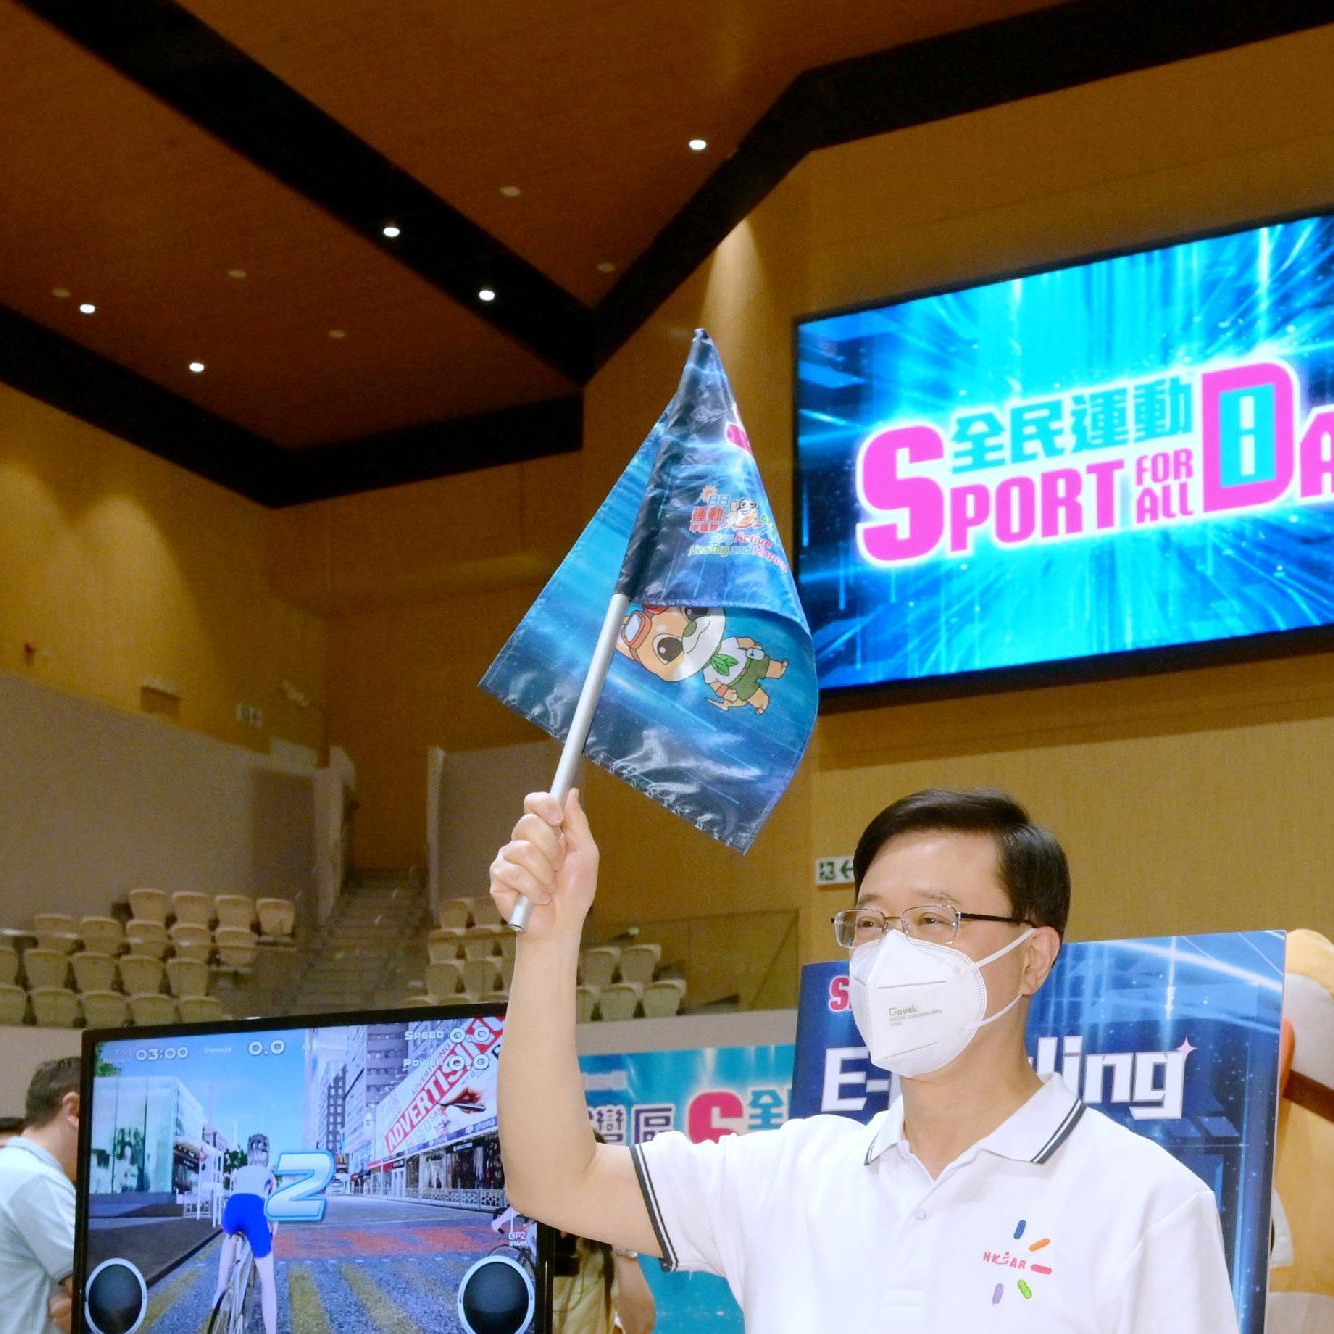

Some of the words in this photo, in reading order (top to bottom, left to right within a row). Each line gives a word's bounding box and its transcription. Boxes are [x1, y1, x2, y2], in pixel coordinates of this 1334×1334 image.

[951, 376, 1193, 474] 全民運動
[1135, 448, 1193, 486] FOR
[859, 427, 1125, 562] SPORT
[1135, 483, 1193, 524] ALL
[135, 1047, 188, 1061] 03:00
[248, 1040, 285, 1056] 0.0
[265, 1149, 338, 1222] 2
